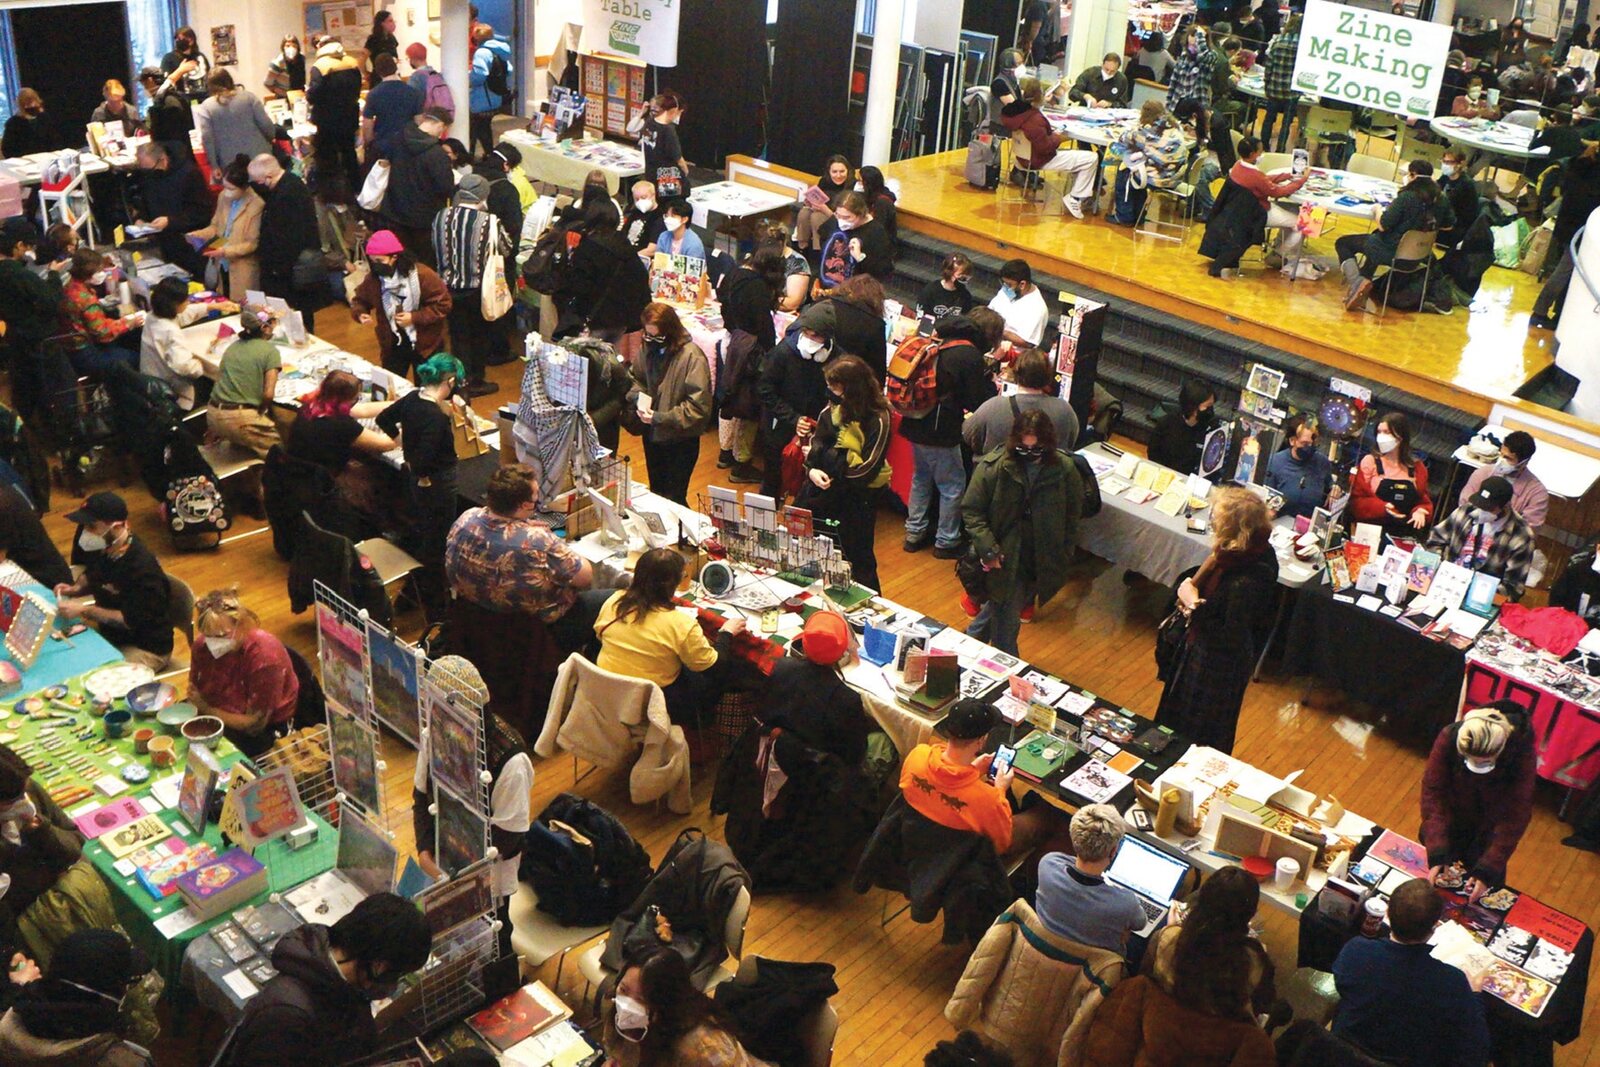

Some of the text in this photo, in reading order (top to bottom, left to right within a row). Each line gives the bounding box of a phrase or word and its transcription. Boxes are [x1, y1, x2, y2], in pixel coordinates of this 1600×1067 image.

[601, 0, 652, 21] Table
[611, 21, 641, 35] ZINE
[1336, 11, 1413, 47] Zine
[1308, 36, 1433, 90] Making
[1323, 71, 1402, 109] Zone
